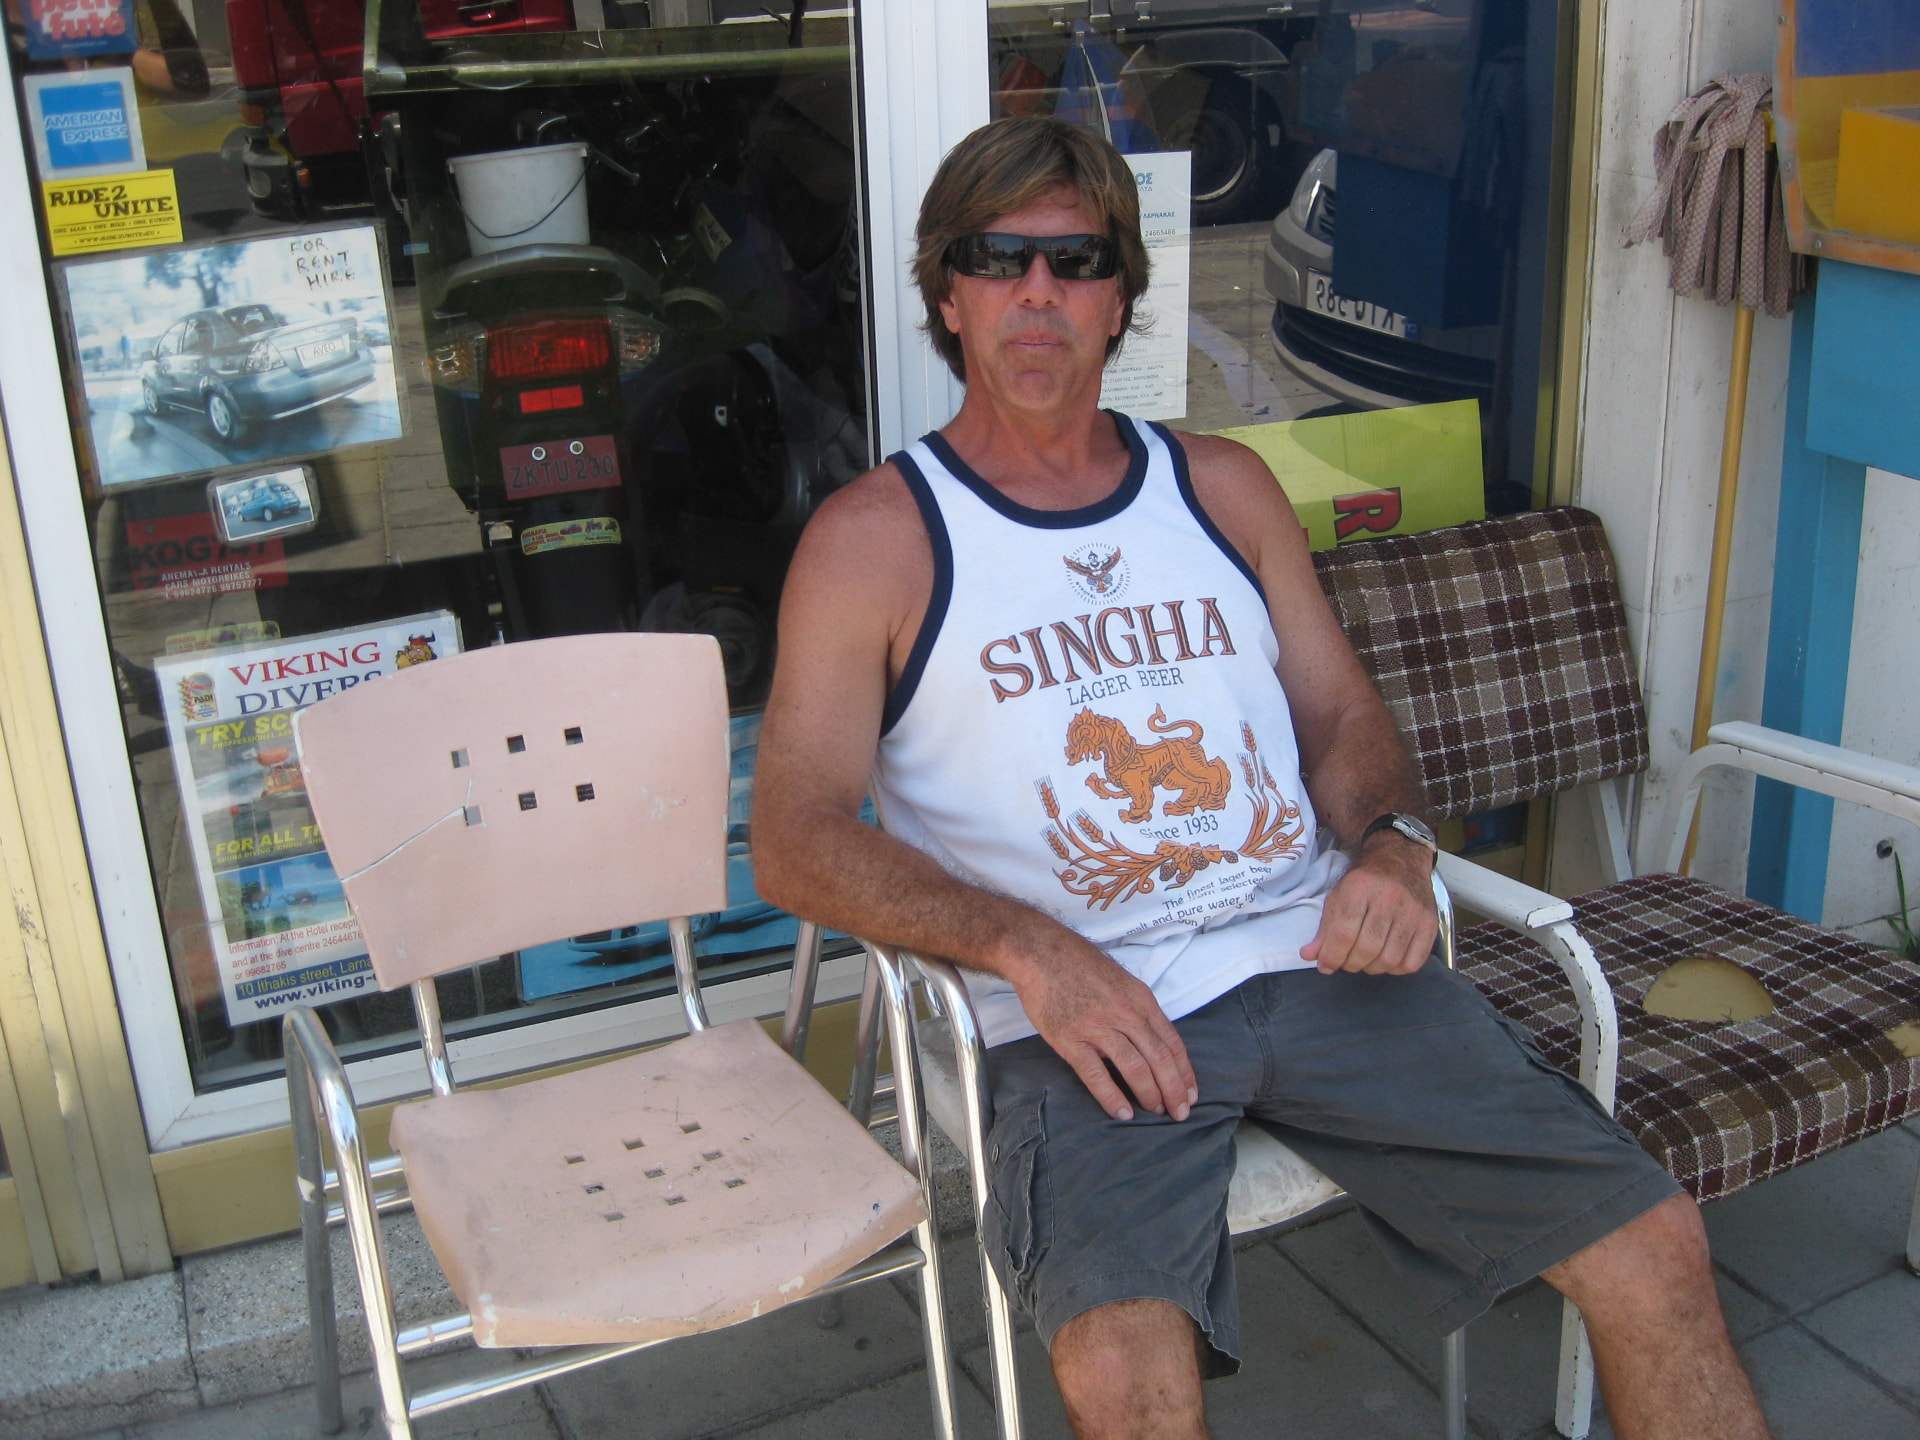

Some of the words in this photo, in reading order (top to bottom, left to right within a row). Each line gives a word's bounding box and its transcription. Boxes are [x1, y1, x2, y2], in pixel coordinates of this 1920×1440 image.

[44, 108, 123, 129] AMERICAN
[63, 124, 129, 144] EXPRESS
[94, 196, 174, 218] UNITE
[290, 237, 328, 255] FOR
[296, 250, 349, 274] RENT
[306, 269, 356, 290] HIRE
[211, 562, 252, 576] RENTALS
[165, 579, 189, 592] CARS
[192, 572, 250, 587] MOTORBIKES
[980, 597, 1238, 703] SINGHA
[228, 642, 381, 686] VIKING
[1066, 674, 1132, 706] LAGER
[1137, 667, 1185, 687] BEER
[195, 720, 247, 745] TRY
[1140, 827, 1180, 840] Since
[1184, 814, 1219, 835] 1933
[215, 838, 254, 857] FOR
[260, 830, 295, 847] ALL
[1162, 896, 1185, 911] The
[1187, 881, 1215, 899] finest
[1219, 871, 1246, 886] lager
[1152, 912, 1173, 927] and
[1177, 905, 1204, 922] pure
[1208, 895, 1240, 911] water
[229, 937, 278, 955] Information:
[280, 933, 290, 943] At
[291, 930, 304, 941] the
[306, 922, 328, 938] Hotel
[232, 957, 248, 969] and
[250, 955, 259, 965] at
[260, 951, 274, 963] the
[275, 946, 293, 959] dive
[294, 941, 321, 954] centre
[234, 972, 243, 981] or
[239, 983, 254, 997] 10
[257, 973, 297, 993] Ithakis
[299, 965, 337, 983] street,
